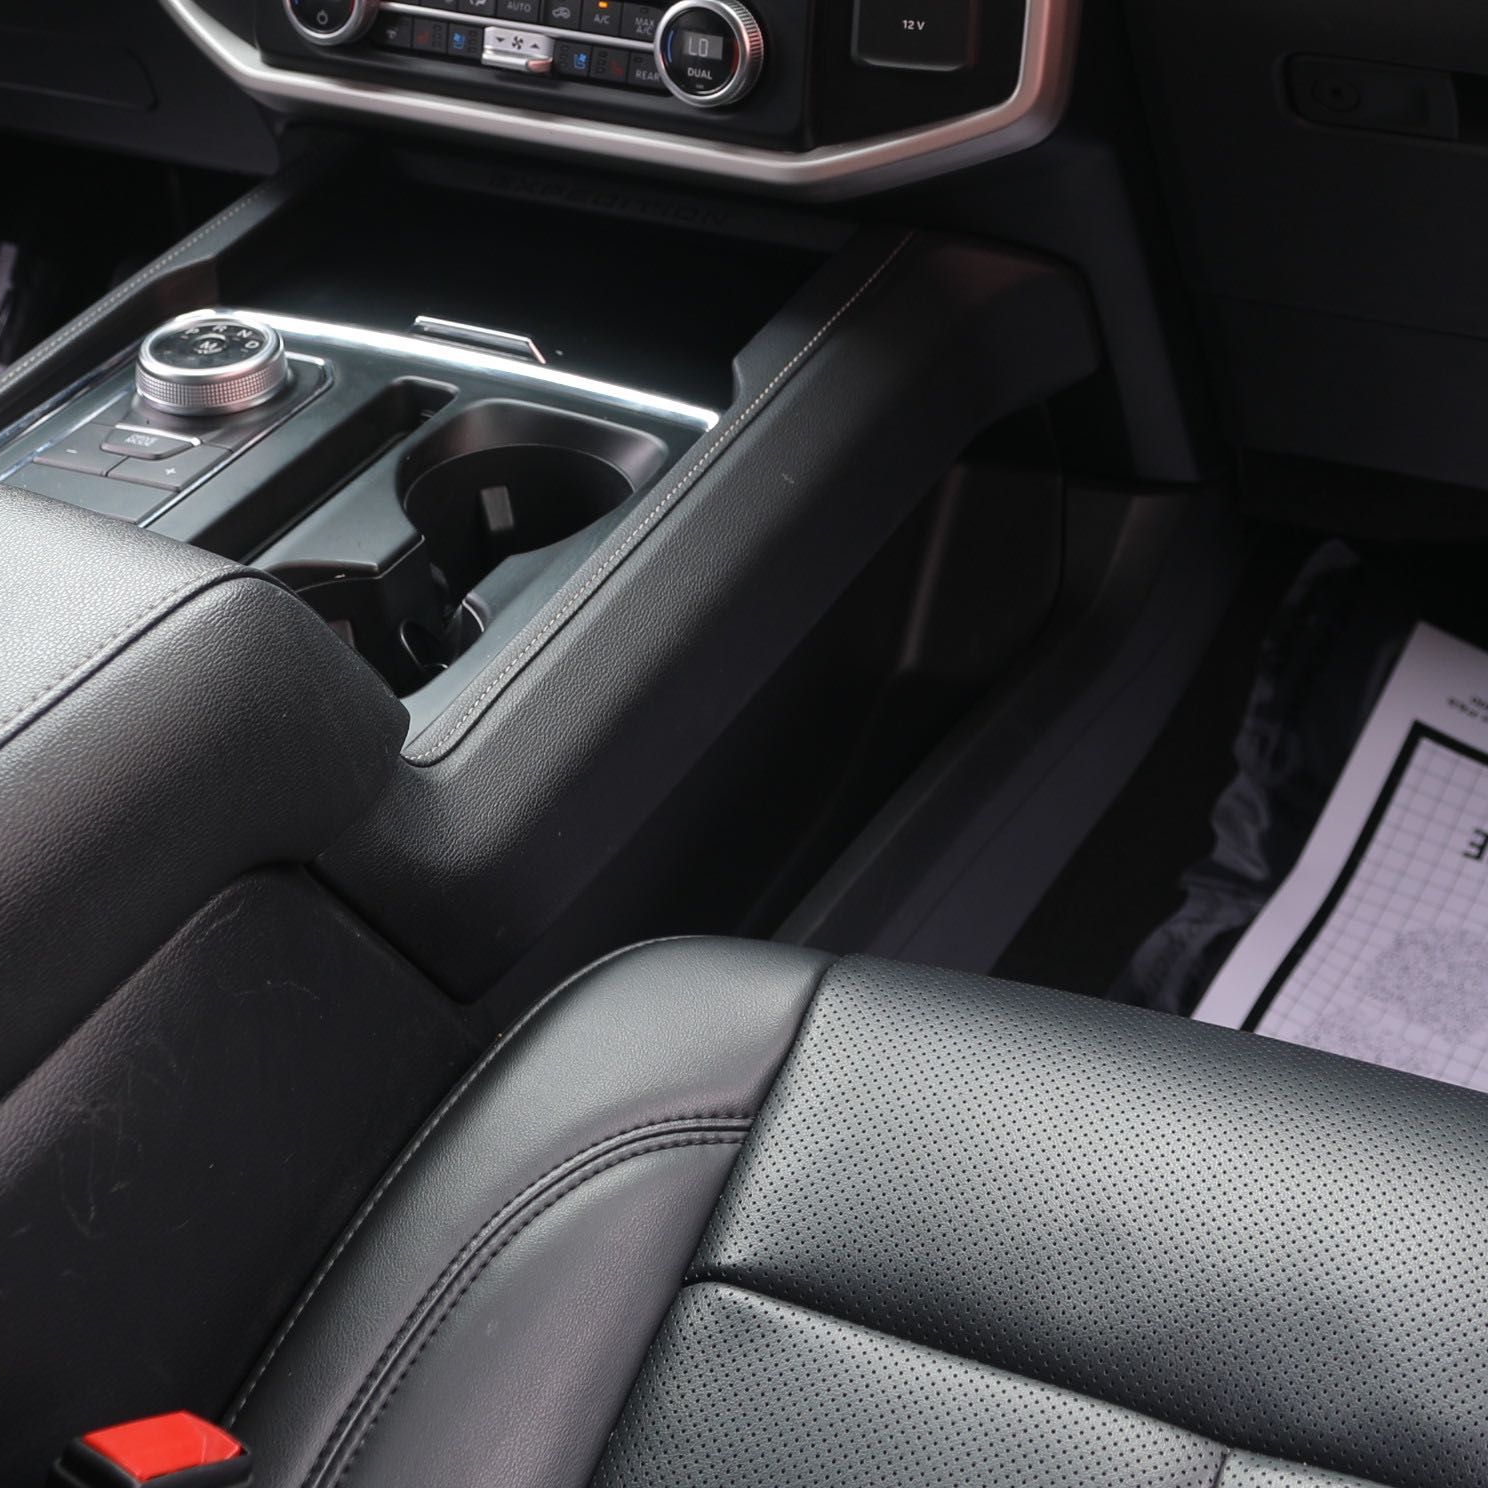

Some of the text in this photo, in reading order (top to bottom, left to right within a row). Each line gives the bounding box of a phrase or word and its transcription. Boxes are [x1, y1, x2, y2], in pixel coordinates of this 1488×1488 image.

[507, 2, 532, 13] AUTO
[593, 13, 610, 26] A/C
[634, 16, 656, 27] MAX
[901, 19, 926, 31] 12 V
[636, 25, 655, 36] A/C
[635, 69, 661, 82] REAR
[687, 67, 713, 80] DUAL
[236, 329, 253, 339] N
[244, 340, 260, 349] D
